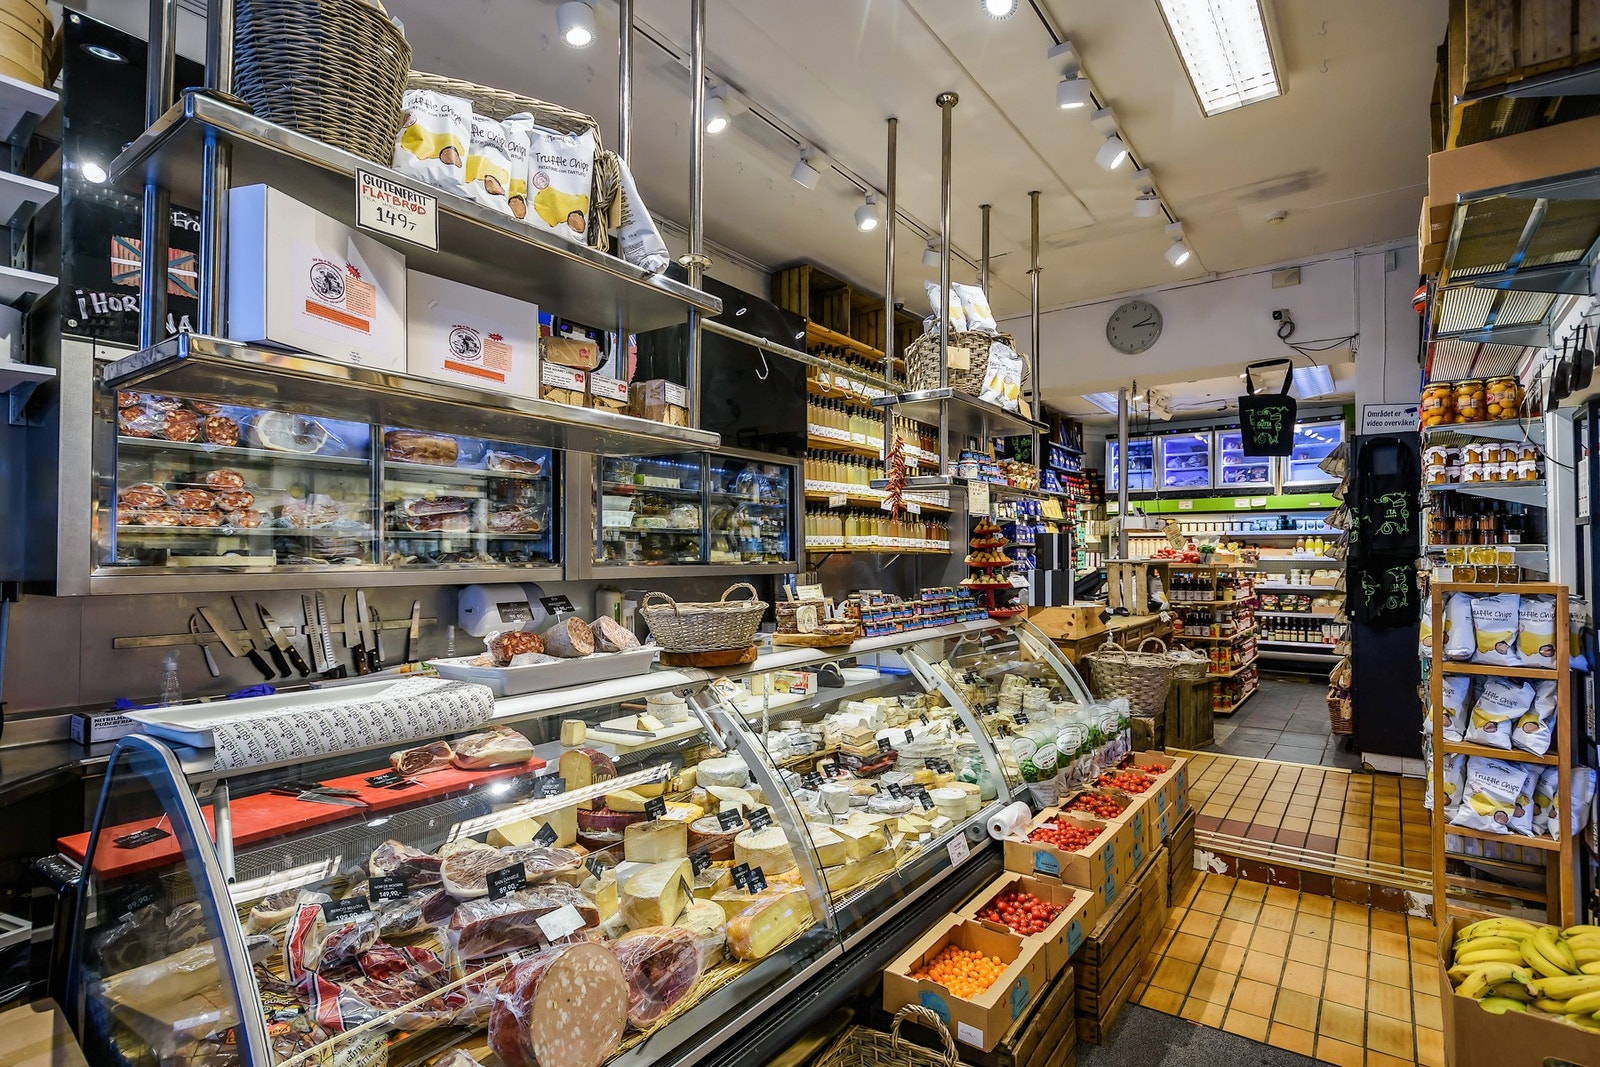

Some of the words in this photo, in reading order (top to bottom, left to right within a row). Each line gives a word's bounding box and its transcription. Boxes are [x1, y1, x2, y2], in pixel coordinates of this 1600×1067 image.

[536, 152, 567, 167] Truffle
[570, 157, 588, 172] Chips
[362, 184, 426, 215] FLATBRØD
[380, 702, 394, 718] GUTTA
[1500, 697, 1518, 707] Chips
[332, 711, 346, 728] GUTTA
[368, 708, 382, 726] GUTTA
[406, 709, 417, 726] GUTTA
[232, 722, 250, 741] GUTTA
[277, 721, 293, 739] GUTTA
[318, 719, 332, 738] GUTTA
[342, 727, 354, 745] GUTTA
[356, 718, 368, 736] GUTTA
[217, 731, 234, 751] GUTTA
[262, 729, 278, 750] GUTTA
[304, 728, 318, 747] GUTTA
[247, 739, 261, 759] GUTTA
[1474, 772, 1500, 786] Truffle
[1501, 781, 1520, 794] Chips
[346, 1044, 365, 1063] GUTTA
